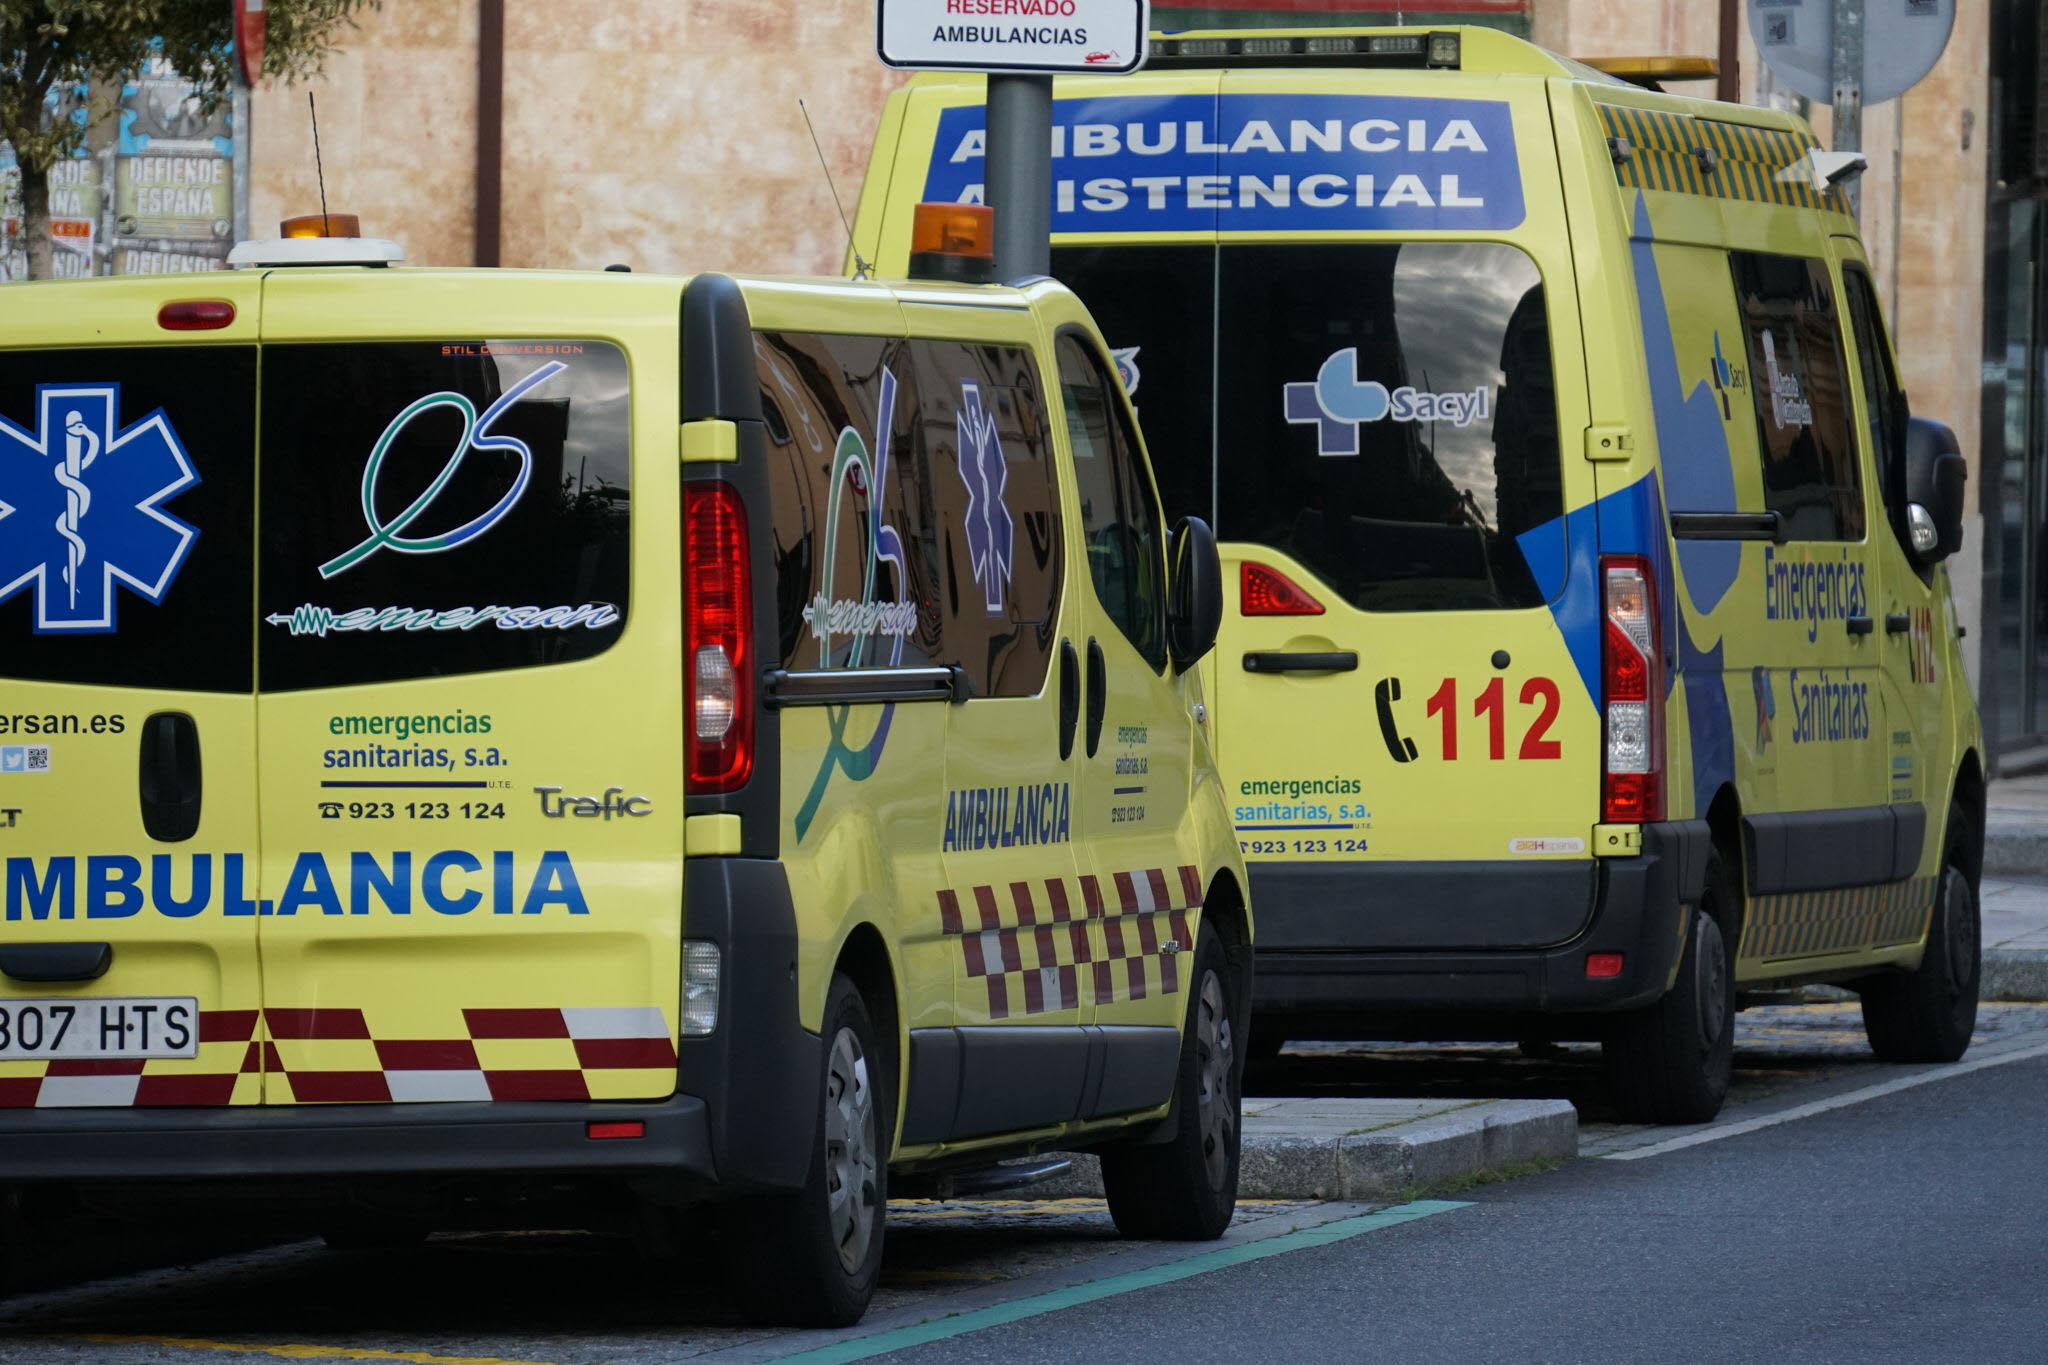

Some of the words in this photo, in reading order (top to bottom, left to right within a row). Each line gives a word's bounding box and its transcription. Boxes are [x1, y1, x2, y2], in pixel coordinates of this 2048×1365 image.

[947, 0, 1076, 16] RESERVADO
[933, 26, 1087, 45] AMBULANCIAS
[949, 119, 1488, 163] ABULANCIA
[129, 157, 224, 184] DEFIENDE
[137, 185, 215, 216] ESPAÑA
[956, 174, 1484, 212] AISTENCIAL
[442, 345, 475, 355] STIL
[480, 345, 584, 355] CONVERSION
[1391, 387, 1488, 426] Sacyl
[1765, 546, 1867, 643] Emergencias
[1427, 677, 1561, 760] 112
[1790, 667, 1869, 744] Sanitarias
[329, 709, 491, 740] emergencias
[323, 743, 456, 772] sanitarias,
[464, 746, 508, 767] s.a.
[1240, 775, 1361, 799] emergencias
[349, 802, 395, 819] 923
[404, 802, 450, 819] 123
[459, 802, 506, 819] 124
[534, 785, 653, 821] Trafic
[943, 783, 1069, 853] AMBULANCIA
[1235, 801, 1333, 823] sanitarias,
[1339, 804, 1372, 819] s.a.
[1251, 841, 1286, 854] 923
[1292, 840, 1326, 853] 123
[1333, 839, 1368, 852] 124
[6, 849, 590, 921] MBULANCIA
